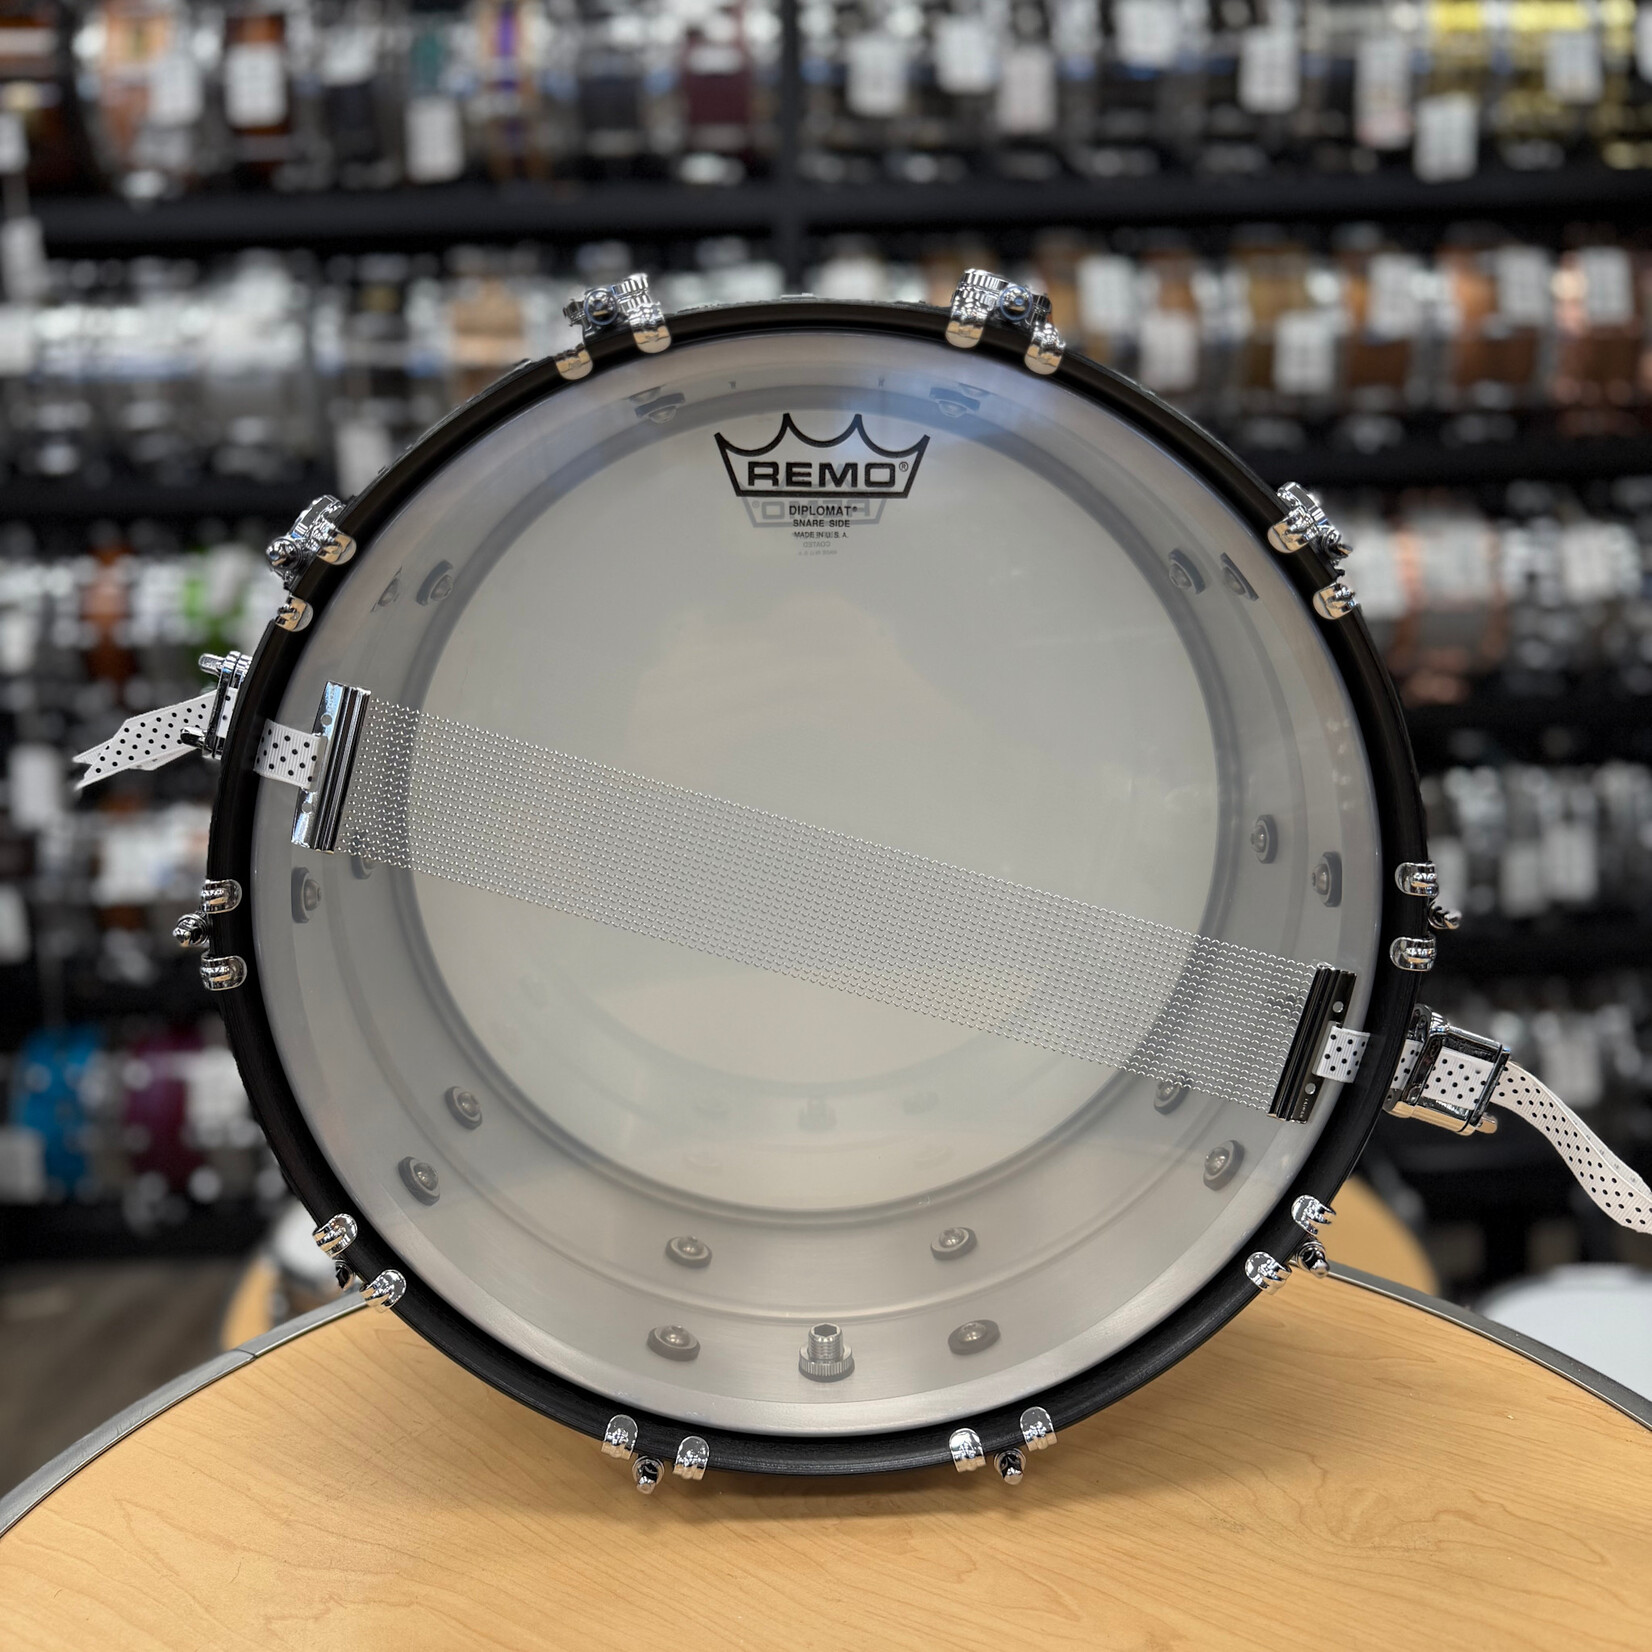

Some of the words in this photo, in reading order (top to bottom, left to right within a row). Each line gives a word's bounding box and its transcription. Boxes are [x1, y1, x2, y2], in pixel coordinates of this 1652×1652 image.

[792, 518, 825, 528] SNARE
[828, 518, 851, 528] SIDE
[793, 531, 815, 539] MADE
[815, 531, 824, 539] IN
